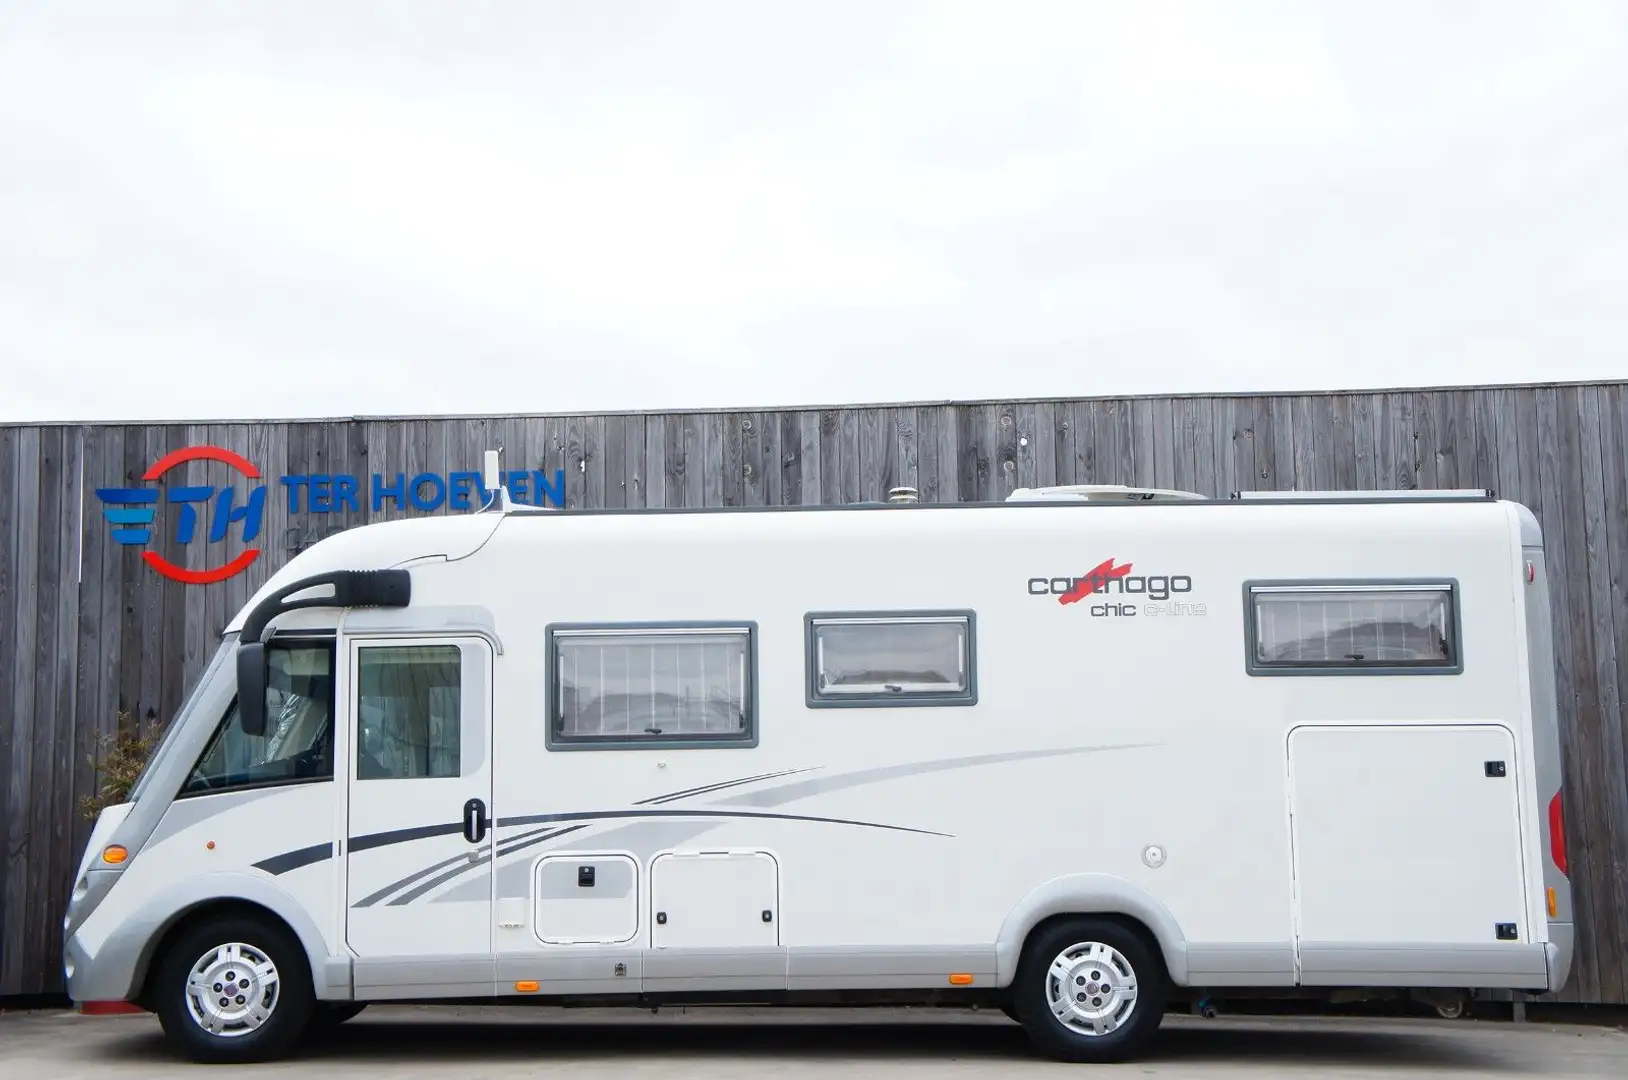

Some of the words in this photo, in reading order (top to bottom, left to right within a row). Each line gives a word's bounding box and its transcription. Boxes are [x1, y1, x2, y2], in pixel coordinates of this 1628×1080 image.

[280, 474, 360, 514] TER
[373, 469, 566, 513] HOEVEN
[1028, 573, 1192, 601] carthago
[1090, 602, 1137, 617] chic
